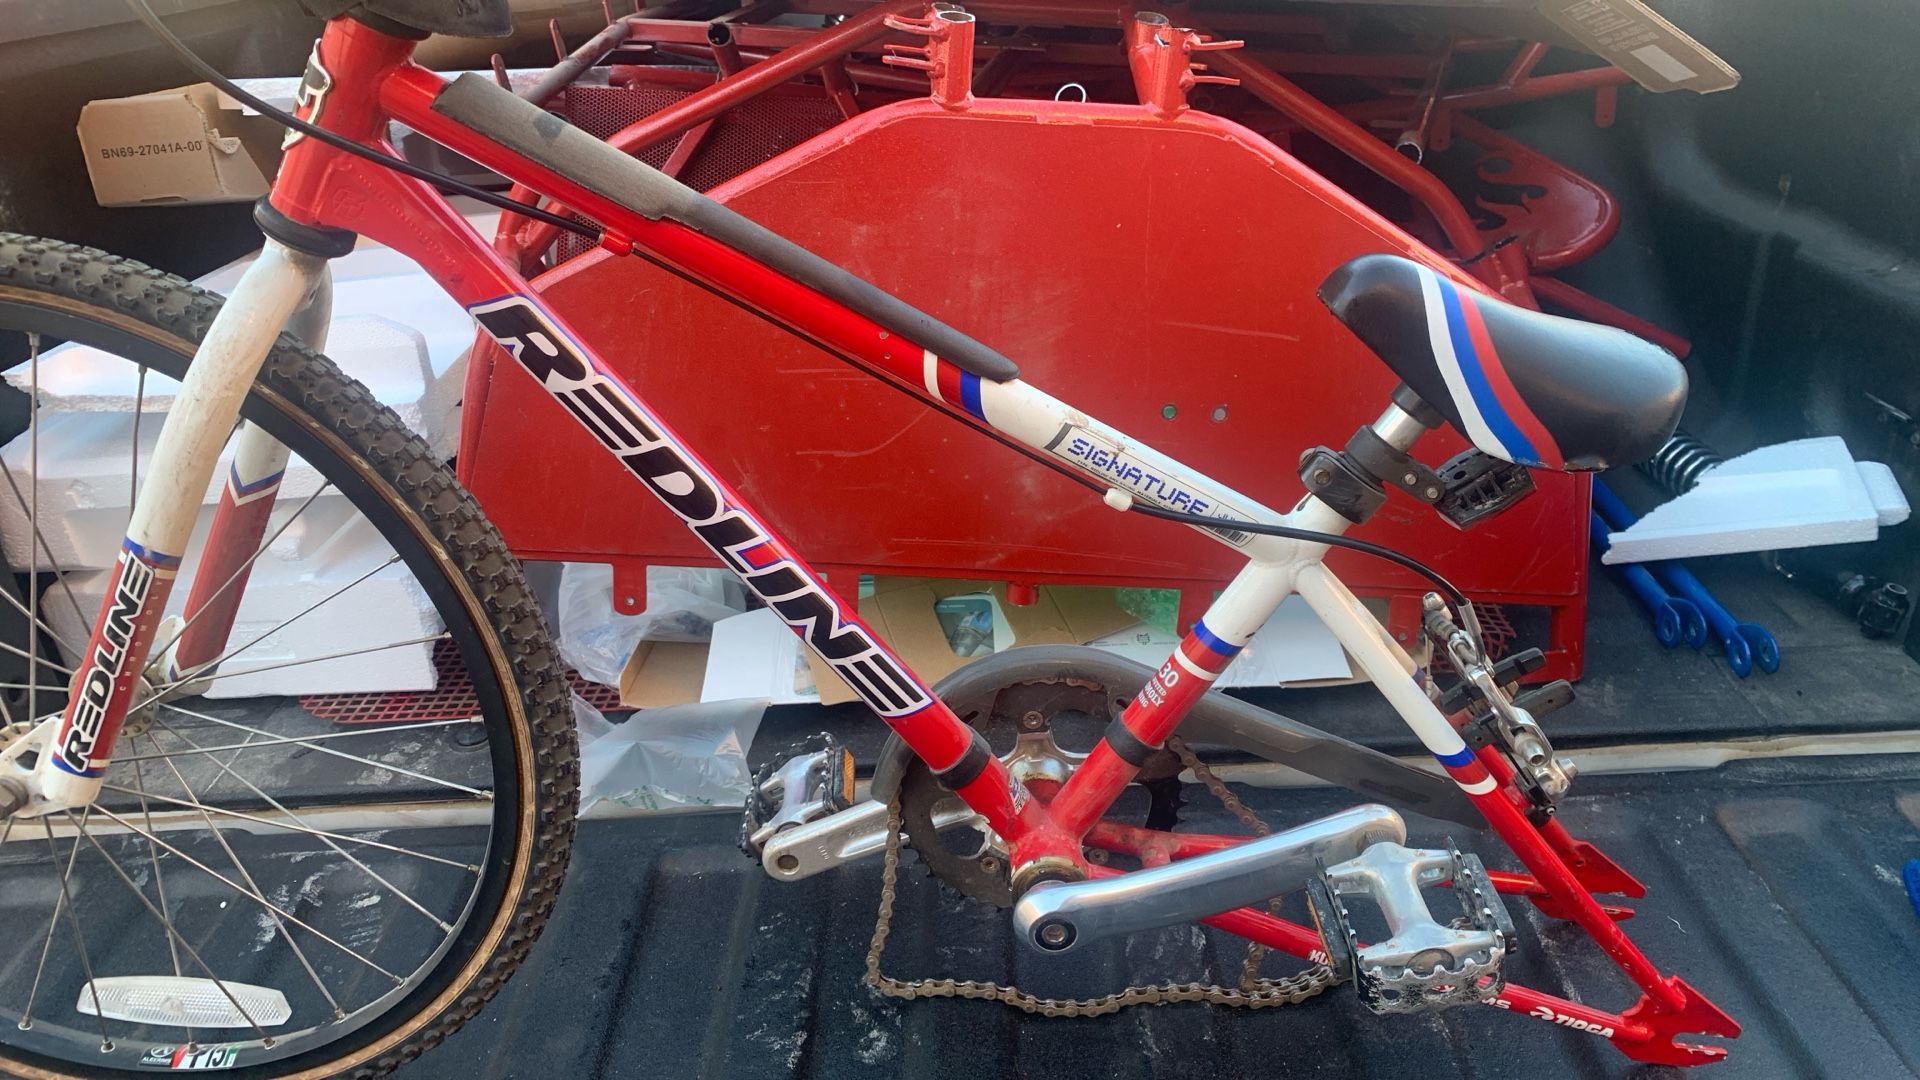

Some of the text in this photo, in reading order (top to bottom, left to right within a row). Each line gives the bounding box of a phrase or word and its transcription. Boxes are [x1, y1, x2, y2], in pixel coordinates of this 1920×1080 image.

[101, 140, 202, 159] BN69-27041A-00
[469, 297, 932, 717] REDLINE
[1067, 437, 1210, 515] SIGNATURE
[62, 550, 155, 772] REDLINE
